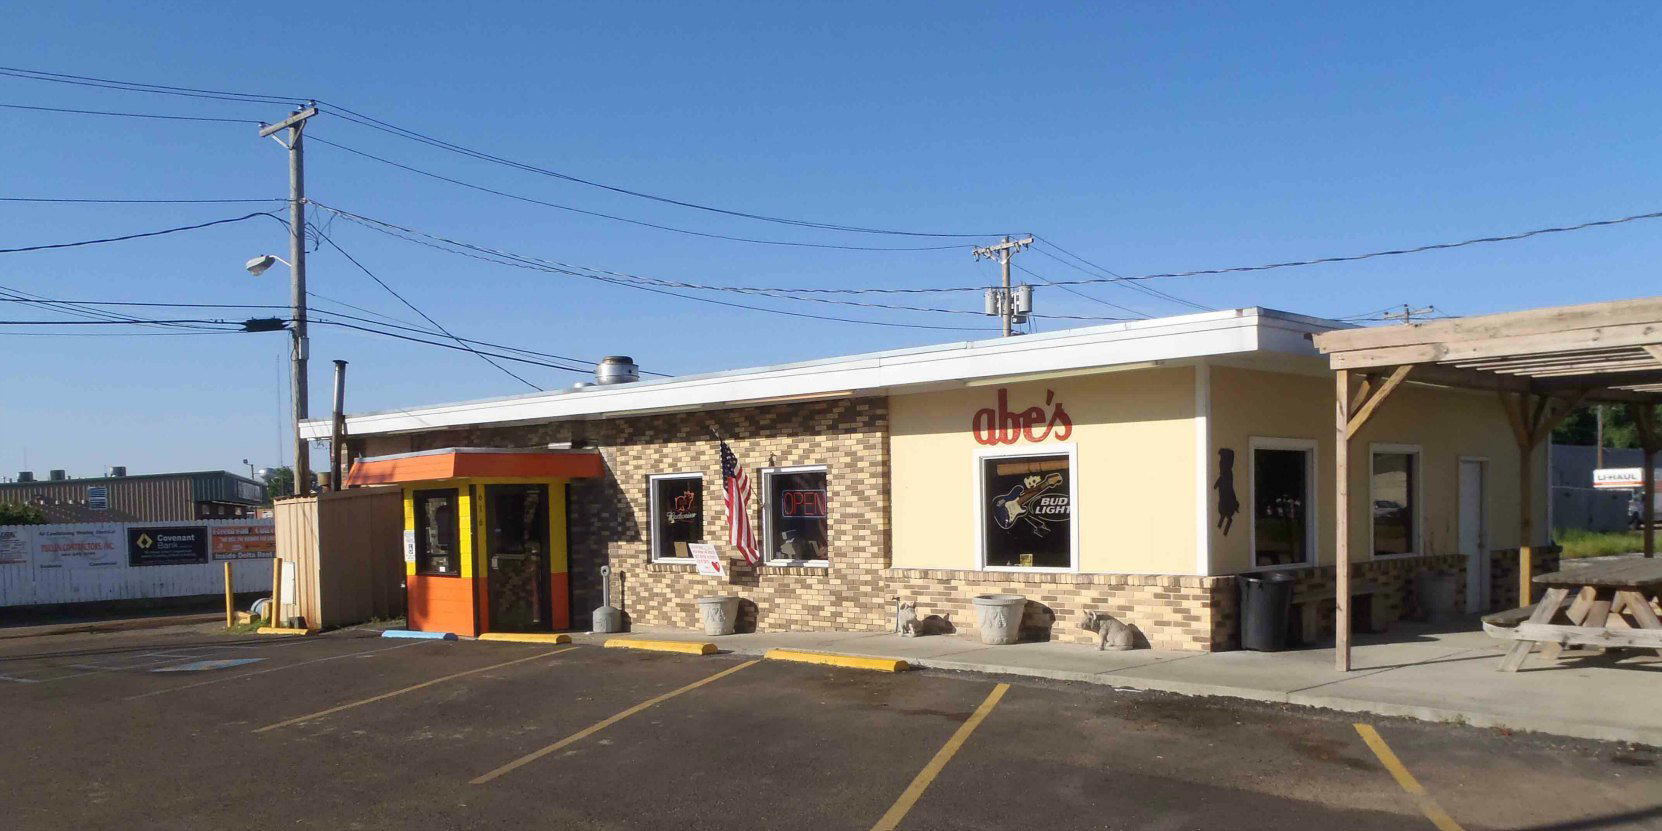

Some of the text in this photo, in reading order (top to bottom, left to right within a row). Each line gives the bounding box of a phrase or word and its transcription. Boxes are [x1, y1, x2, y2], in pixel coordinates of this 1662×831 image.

[973, 388, 1073, 446] abe's
[784, 491, 827, 516] OPEN
[1040, 497, 1068, 506] BUD
[1035, 505, 1071, 515] LIGHT
[157, 534, 196, 542] Covenant
[157, 541, 178, 549] Bank
